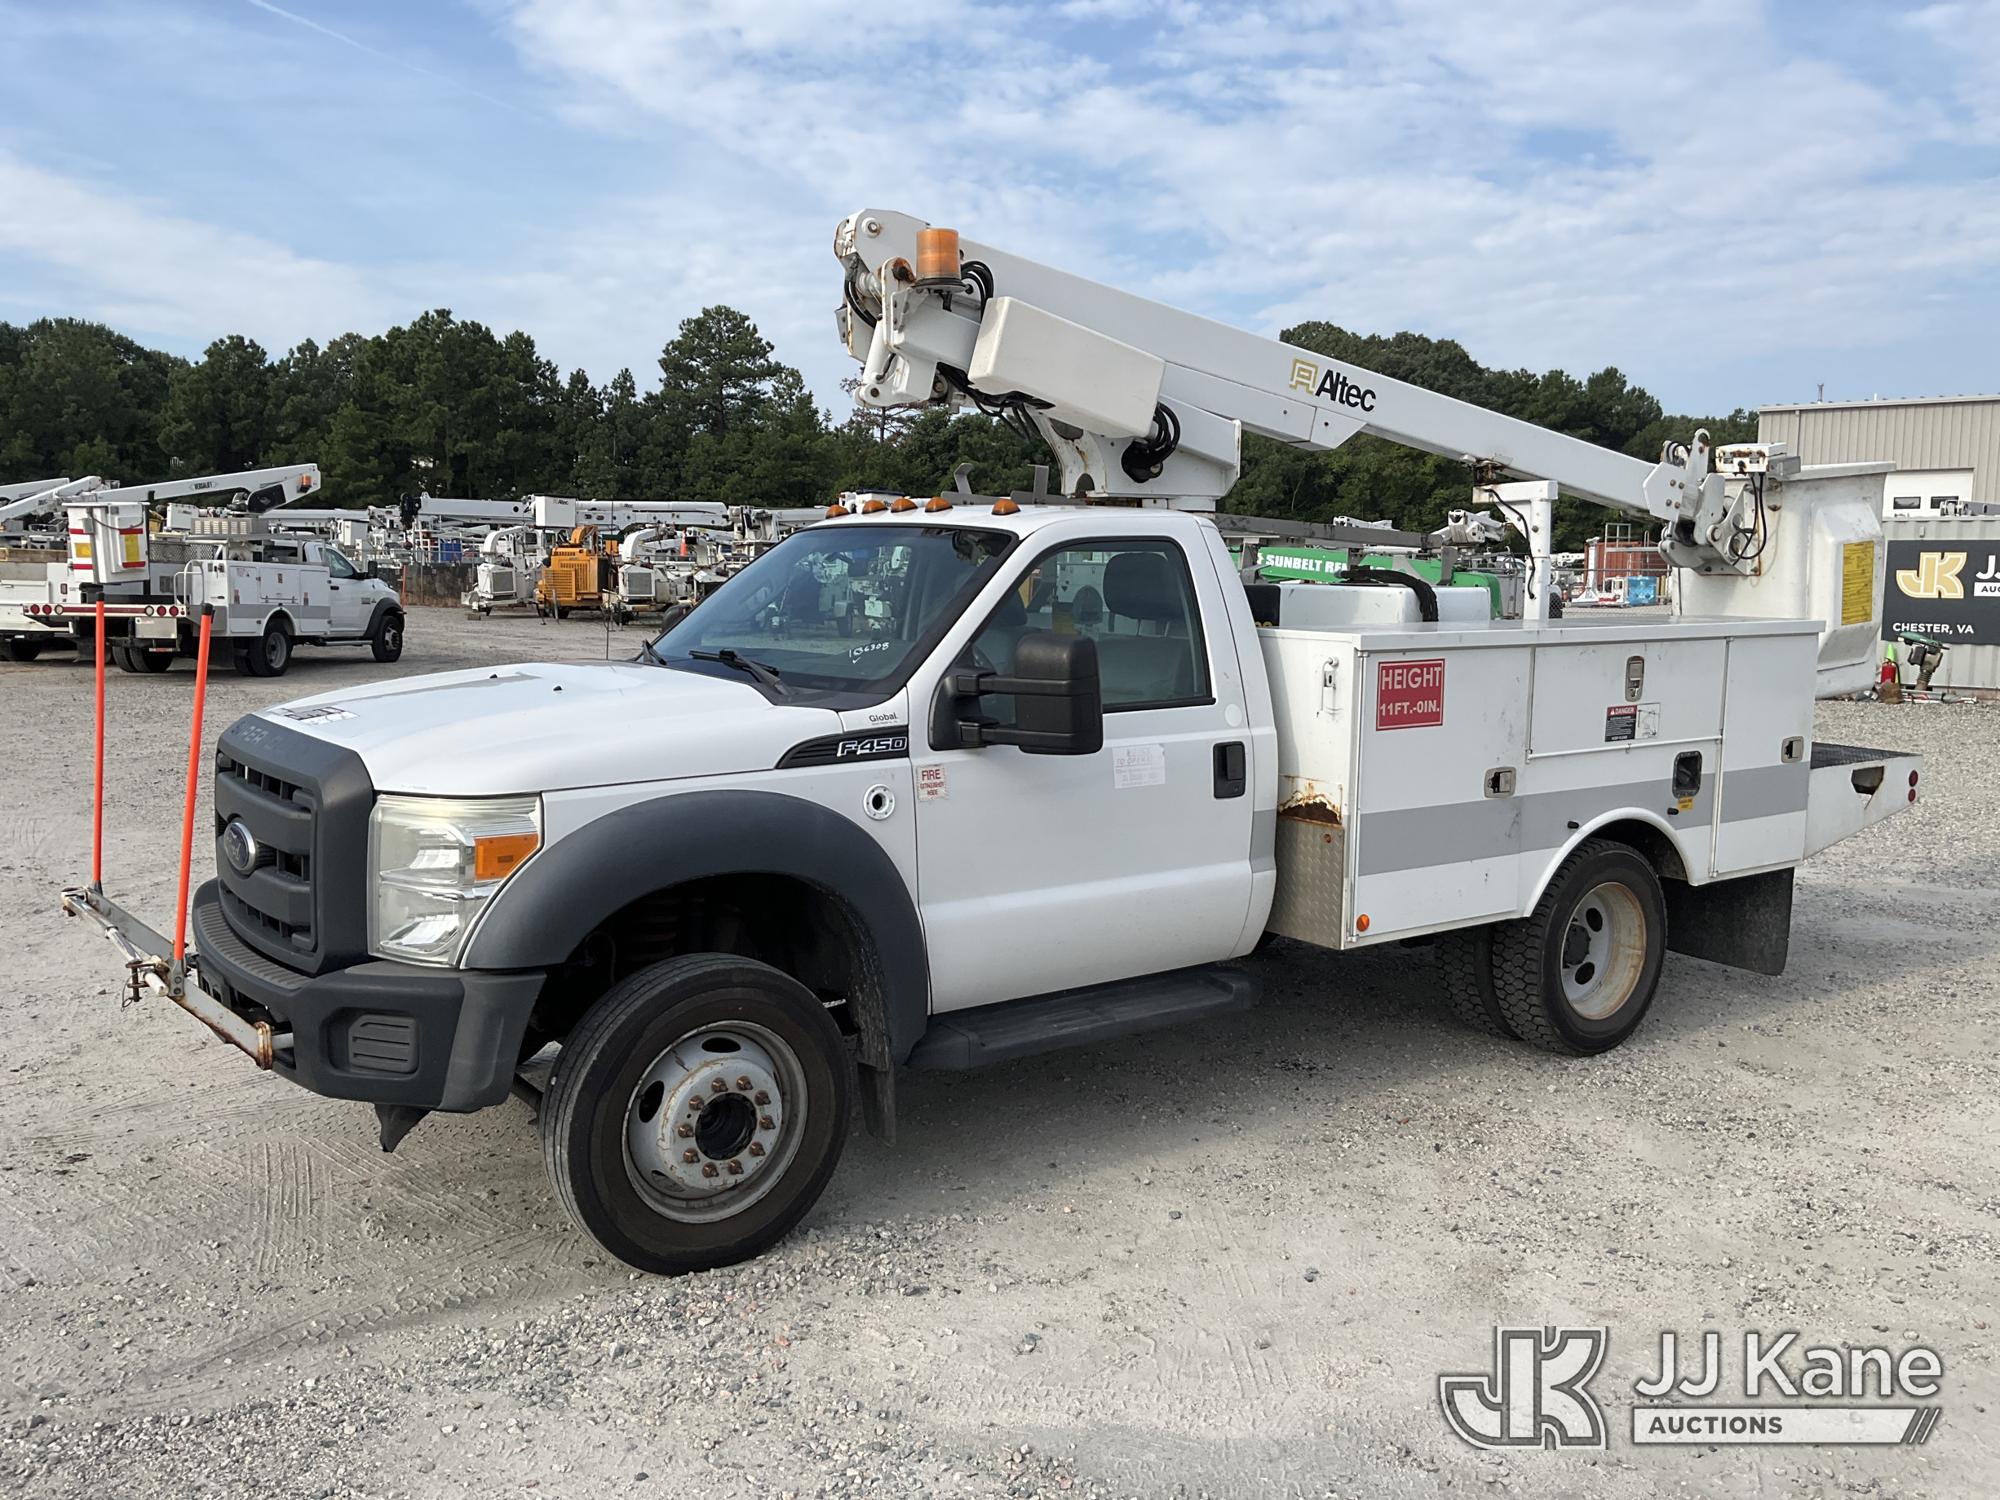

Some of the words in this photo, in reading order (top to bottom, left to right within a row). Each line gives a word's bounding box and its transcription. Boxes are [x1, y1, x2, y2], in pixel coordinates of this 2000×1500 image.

[1315, 369, 1376, 412] Altec
[1266, 554, 1322, 571] SUNBELT
[1896, 551, 1967, 599] JK
[1892, 622, 1953, 634] CHESTER,
[1957, 624, 1974, 634] VA
[1382, 667, 1442, 690] HEIGHT
[869, 711, 897, 722] Global
[837, 737, 907, 756] F-450
[921, 769, 941, 781] FIRE
